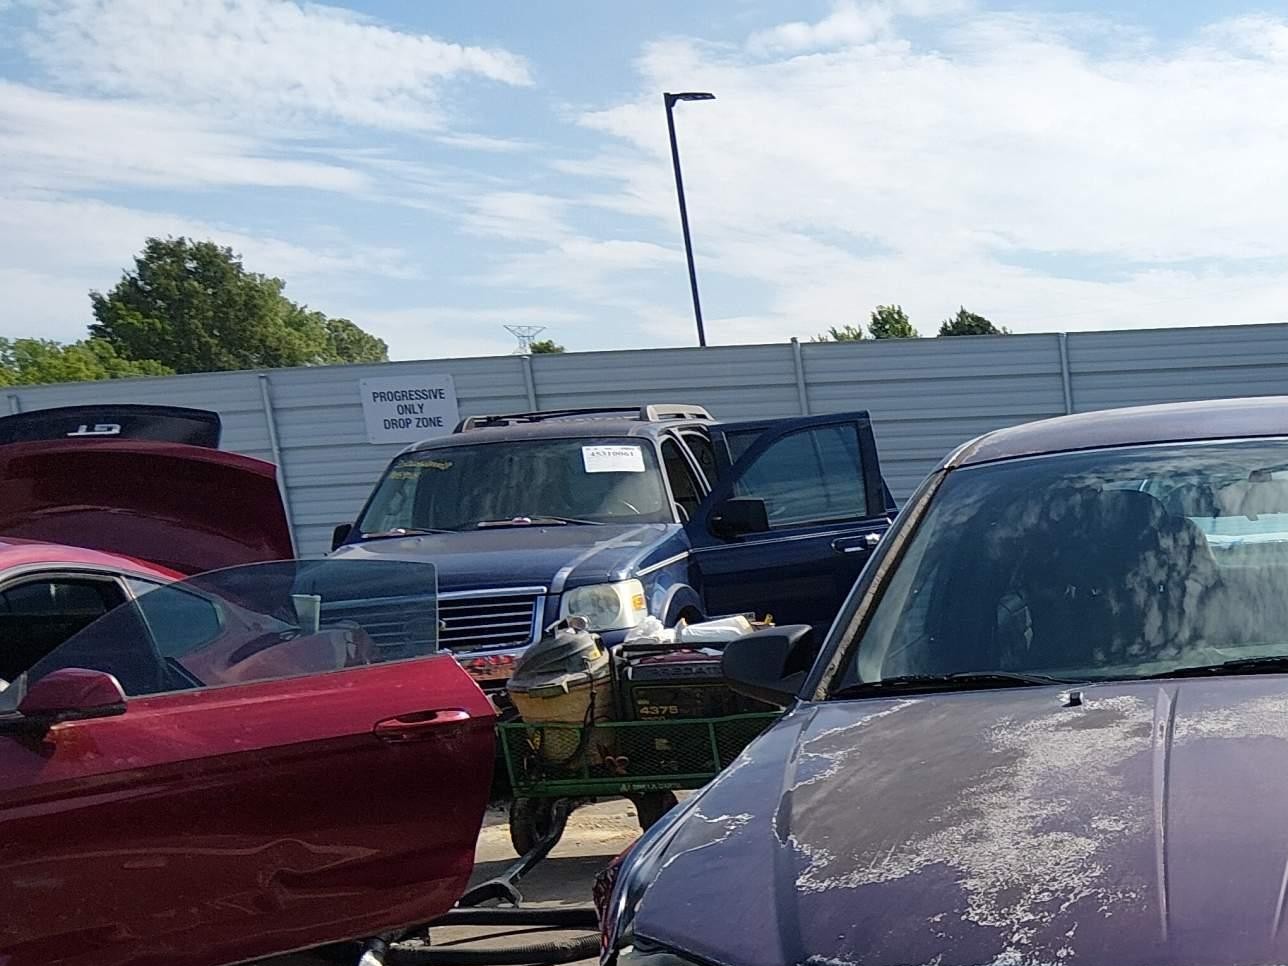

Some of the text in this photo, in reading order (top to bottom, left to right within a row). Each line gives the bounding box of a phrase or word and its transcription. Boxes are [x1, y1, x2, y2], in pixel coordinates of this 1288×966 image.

[372, 388, 446, 403] PROGRESSIVE
[396, 403, 425, 416] ONLY
[383, 416, 444, 430] DROP ZONE
[639, 705, 680, 715] 4375
